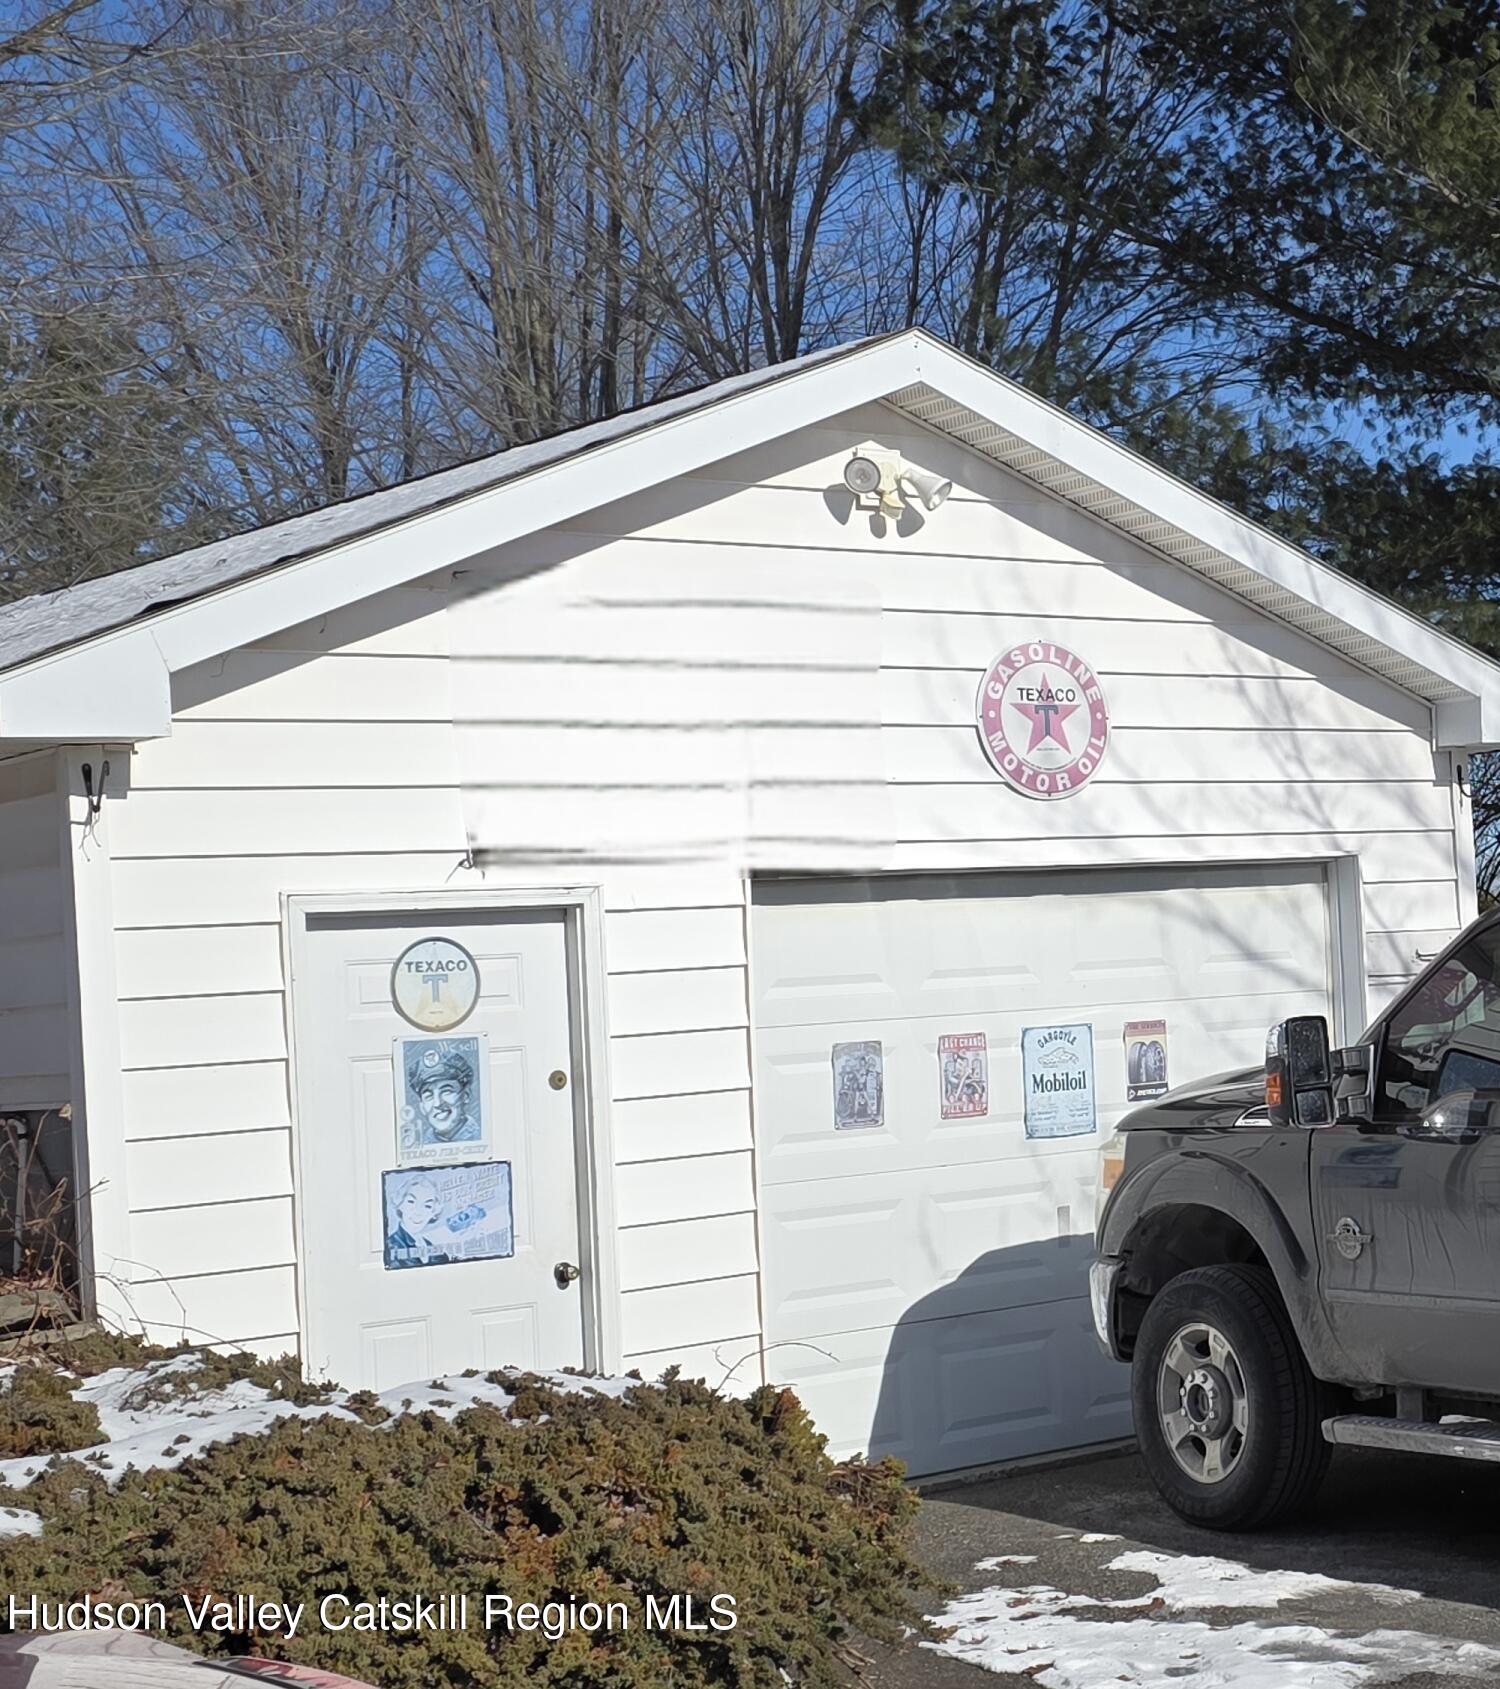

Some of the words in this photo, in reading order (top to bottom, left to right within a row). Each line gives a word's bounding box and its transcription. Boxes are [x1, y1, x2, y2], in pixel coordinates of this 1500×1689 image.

[986, 643, 1102, 705] GASOLINE
[1016, 687, 1076, 703] TEXACO
[988, 730, 1072, 792] MOTOR
[1077, 734, 1106, 776] OIL
[403, 960, 468, 973] TEXACO
[1037, 1030, 1077, 1049] GARGOYLE
[1032, 1070, 1087, 1094] Mobiloil
